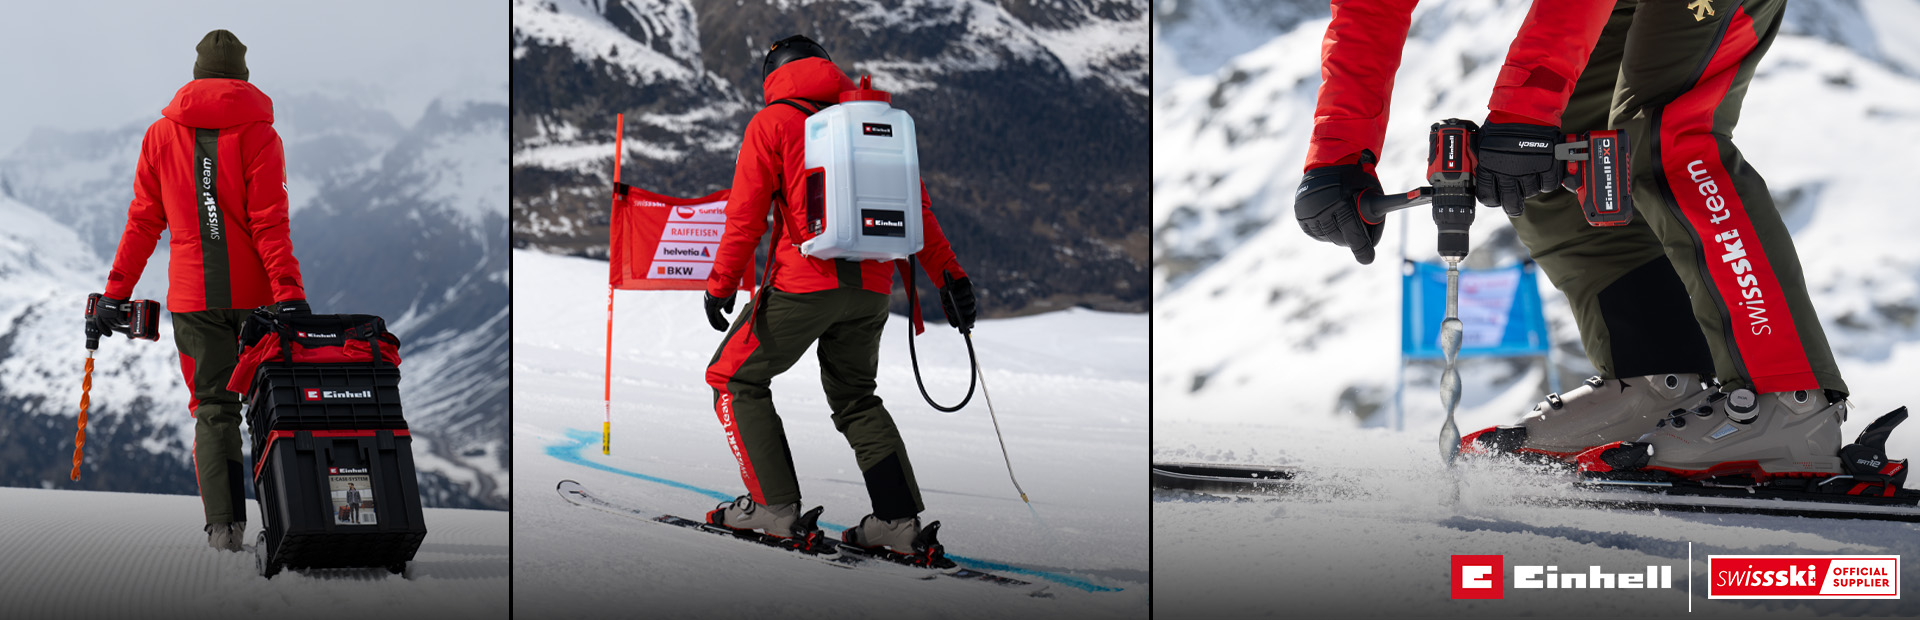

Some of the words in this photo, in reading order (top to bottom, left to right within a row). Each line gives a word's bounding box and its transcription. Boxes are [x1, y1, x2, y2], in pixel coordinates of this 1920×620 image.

[1518, 140, 1549, 149] reusch
[1602, 138, 1611, 164] PXC
[1604, 165, 1613, 210] Einhell
[1686, 159, 1732, 225] team
[875, 219, 903, 227] Einhell
[671, 227, 719, 237] RAIFFEISEN
[663, 247, 700, 257] helvetia
[667, 266, 694, 276] BKW
[1714, 228, 1772, 336] swissski
[322, 390, 372, 399] Einhell
